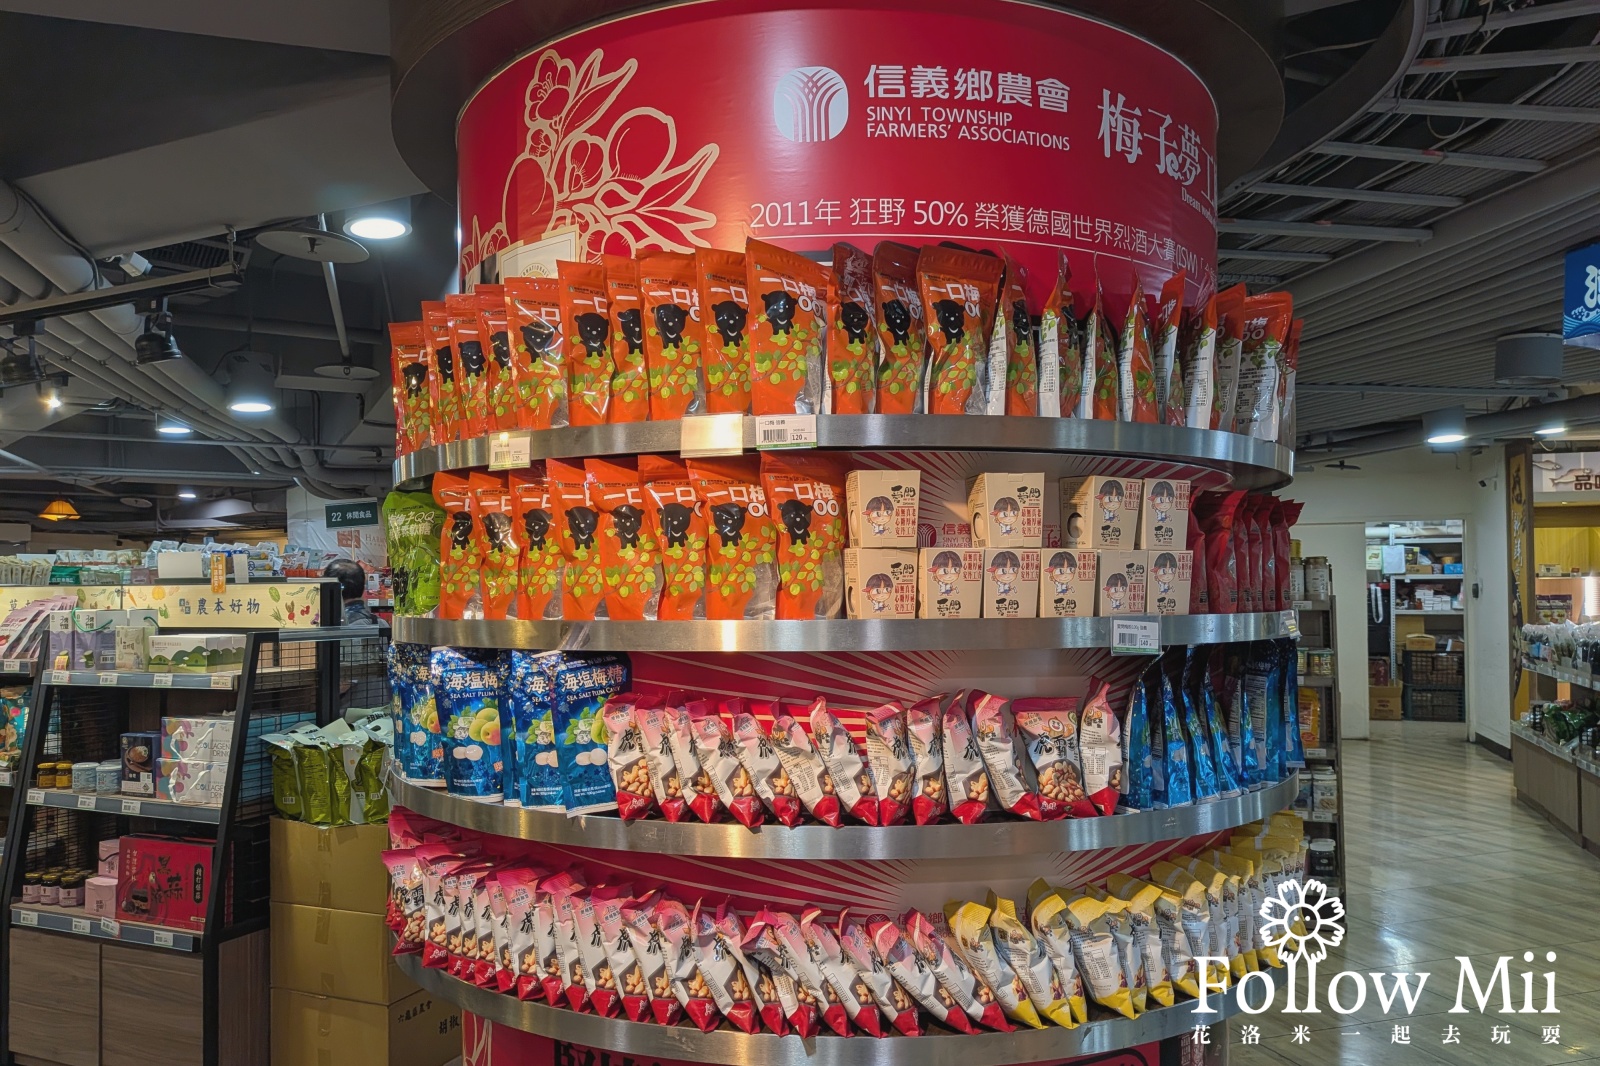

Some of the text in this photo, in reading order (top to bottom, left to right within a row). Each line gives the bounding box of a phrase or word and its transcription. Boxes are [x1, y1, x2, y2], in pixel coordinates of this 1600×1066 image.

[864, 64, 1071, 113] 信義鄉農會
[866, 106, 1013, 126] SINYI TOWNSHIP
[957, 125, 1070, 151] ASSOCIATIONS
[1097, 87, 1218, 206] 梅子夢工
[750, 198, 842, 228] 2011年
[850, 198, 905, 226] 狂野
[913, 200, 968, 227] 50%
[760, 276, 816, 301] 一口梅
[930, 282, 980, 301] 一口梅
[775, 482, 834, 500] 一口梅
[331, 512, 342, 522] 22
[197, 597, 260, 615] 農本好物
[560, 664, 623, 692] 海塩梅糖
